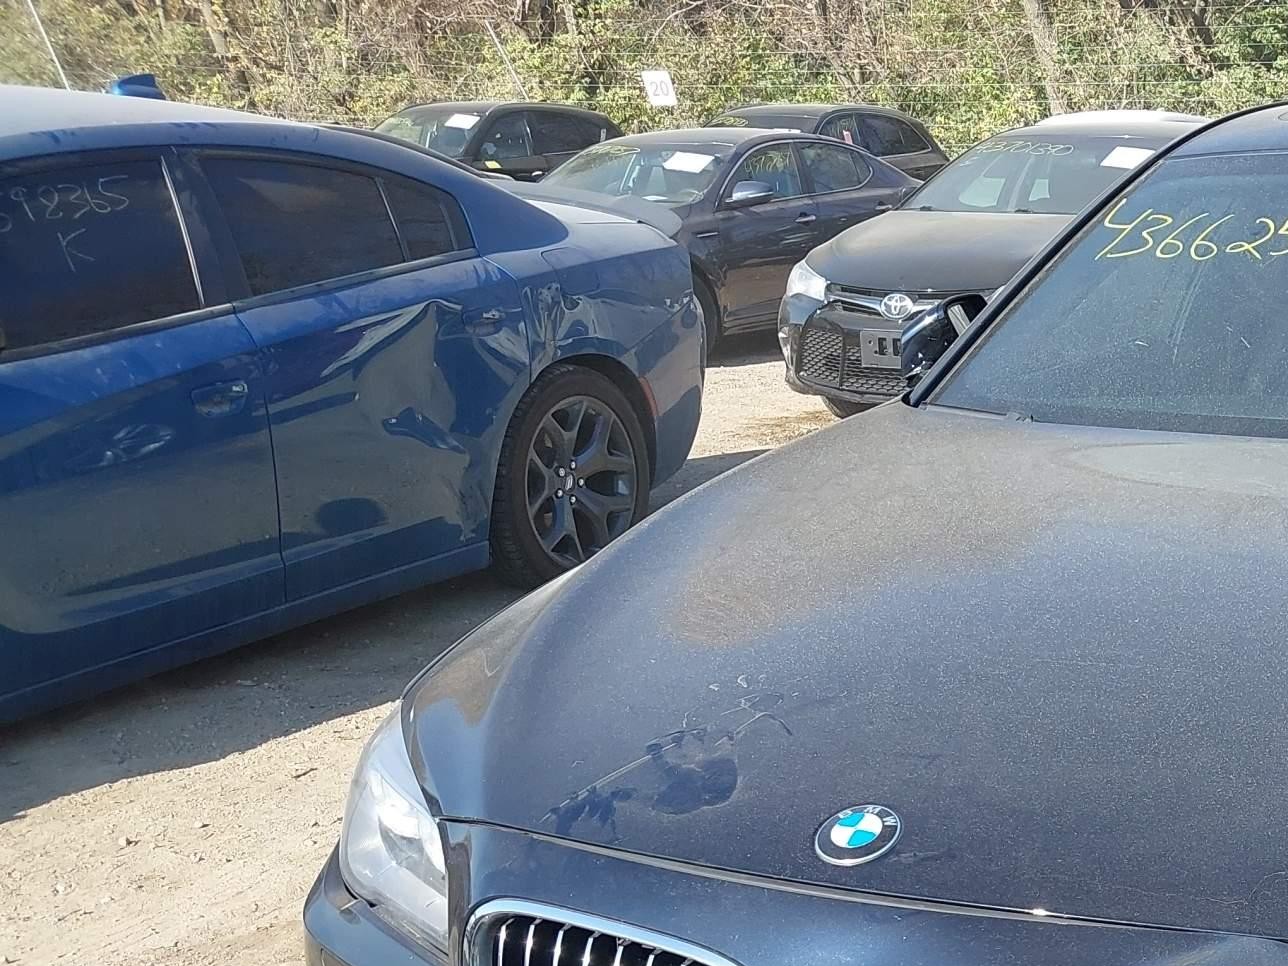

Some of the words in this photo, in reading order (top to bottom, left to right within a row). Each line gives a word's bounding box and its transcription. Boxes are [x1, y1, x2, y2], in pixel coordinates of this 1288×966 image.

[650, 80, 669, 97] 20
[57, 228, 96, 272] K
[838, 806, 898, 826] BMW
